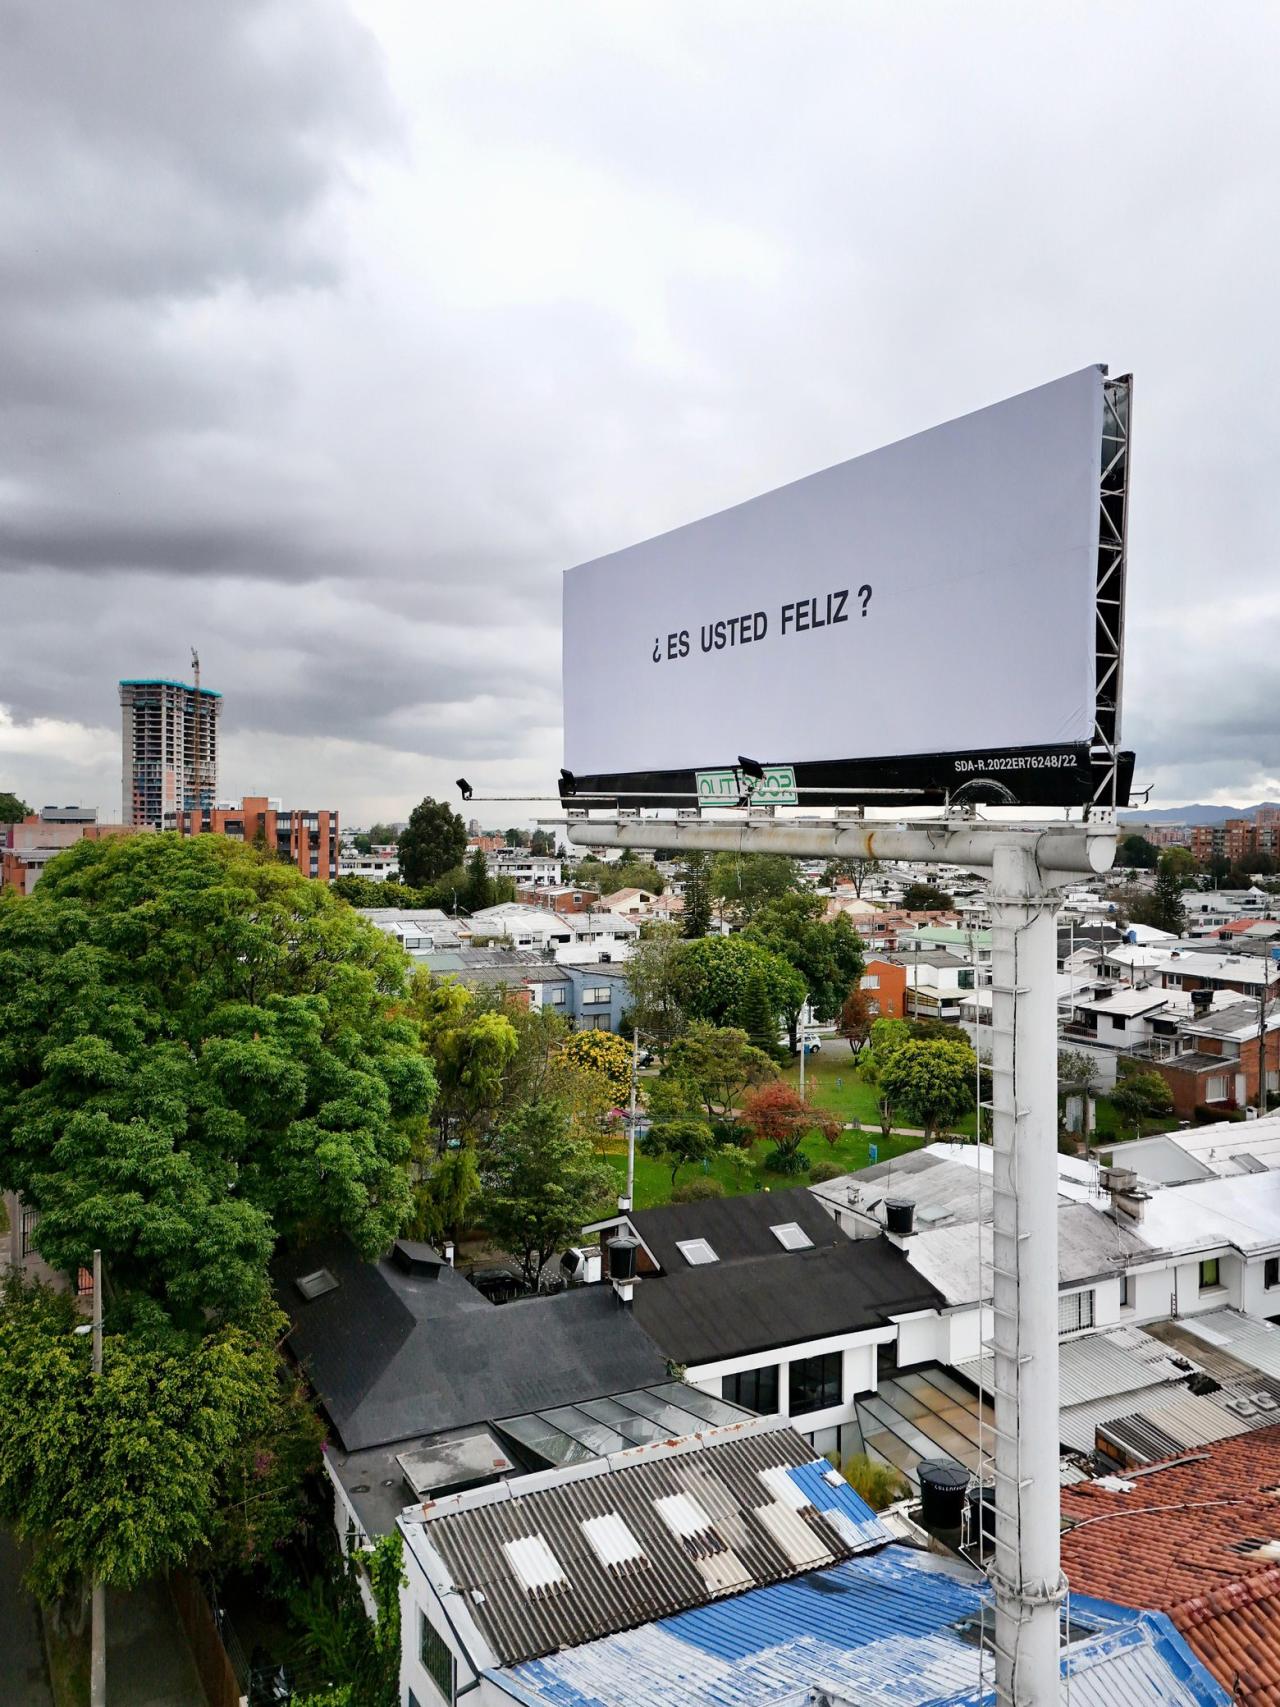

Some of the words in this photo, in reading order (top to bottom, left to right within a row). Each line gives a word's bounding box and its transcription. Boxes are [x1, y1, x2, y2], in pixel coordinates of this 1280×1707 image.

[702, 612, 767, 652] USTED
[782, 590, 848, 635] FELIZ
[954, 754, 1078, 772] SDA-R.2022ER76248/22
